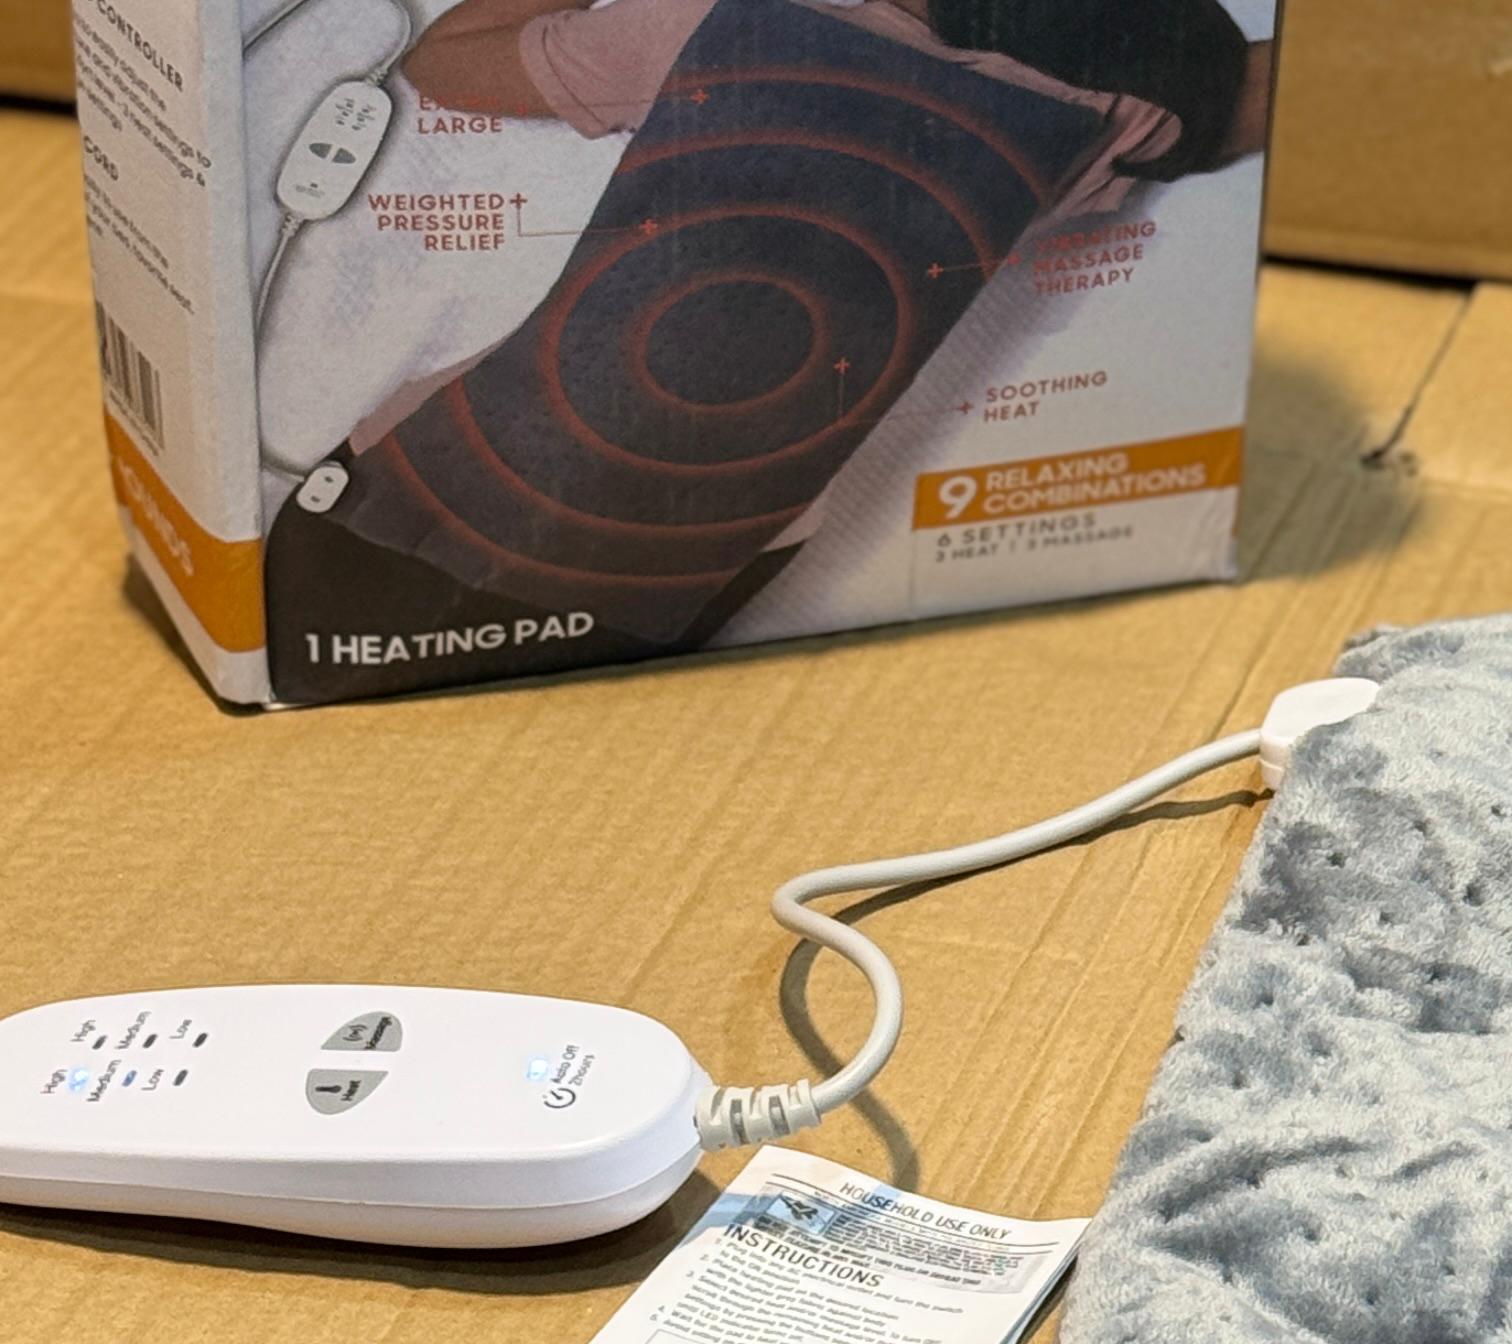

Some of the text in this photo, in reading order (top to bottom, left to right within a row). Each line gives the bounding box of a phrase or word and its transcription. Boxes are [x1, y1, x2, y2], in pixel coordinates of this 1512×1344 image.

[417, 117, 504, 134] LARGE
[368, 193, 505, 211] WEIGHTED
[377, 214, 505, 231] PRESSURE
[424, 234, 505, 251] RELIEF
[1034, 244, 1144, 273] MASSAGE
[1034, 268, 1134, 294] THERAPY
[986, 370, 1108, 403] SOOTHING
[984, 402, 1040, 423] HEAT
[939, 452, 1129, 519] 9 RELAXING
[983, 463, 1207, 514] COMBINATIONS
[938, 513, 1097, 548] 6 SETTINGS
[951, 543, 999, 561] HEAT
[305, 612, 595, 664] 1 HEATING PAD
[70, 1019, 97, 1043] High
[114, 1011, 152, 1050] Medium
[169, 1019, 193, 1039] Low
[40, 1069, 68, 1094] High
[86, 1059, 122, 1102] Medium
[141, 1068, 165, 1091] Low
[550, 1060, 571, 1085] Auto
[340, 1080, 362, 1102] Heat
[839, 1182, 1013, 1240] HOUSEHOLD USE ONLY
[723, 1223, 885, 1289] INSTRUCTIONS
